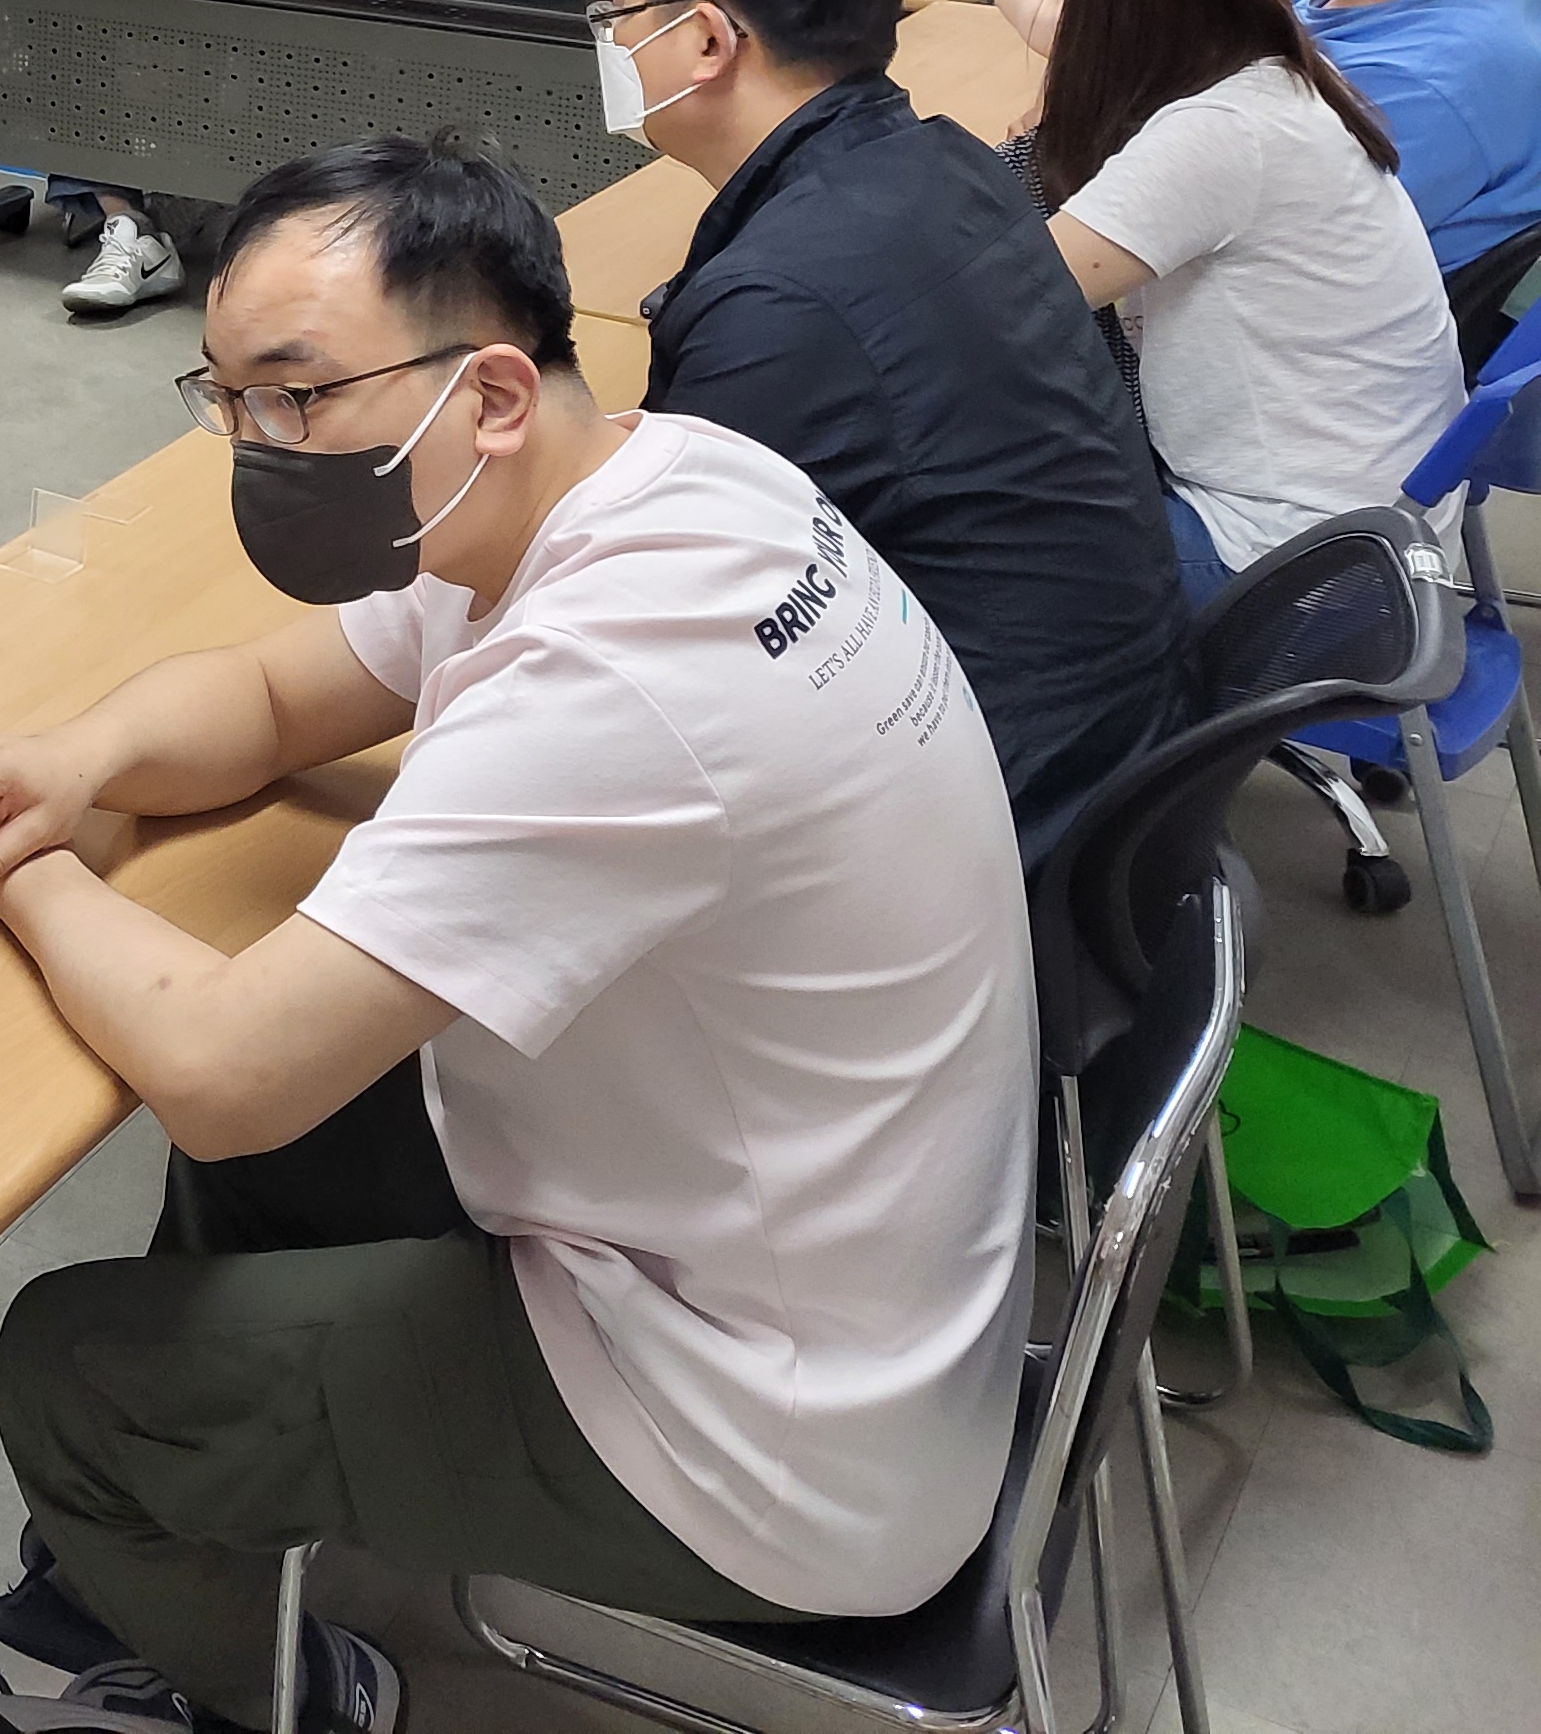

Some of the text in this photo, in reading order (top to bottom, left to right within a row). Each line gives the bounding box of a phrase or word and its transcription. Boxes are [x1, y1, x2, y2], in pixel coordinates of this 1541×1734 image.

[808, 652, 845, 690] LET'S
[840, 633, 864, 661] ALL
[875, 706, 905, 735] Green
[900, 689, 919, 709] save
[908, 690, 935, 727] because
[916, 730, 930, 746] we
[925, 712, 943, 733] have
